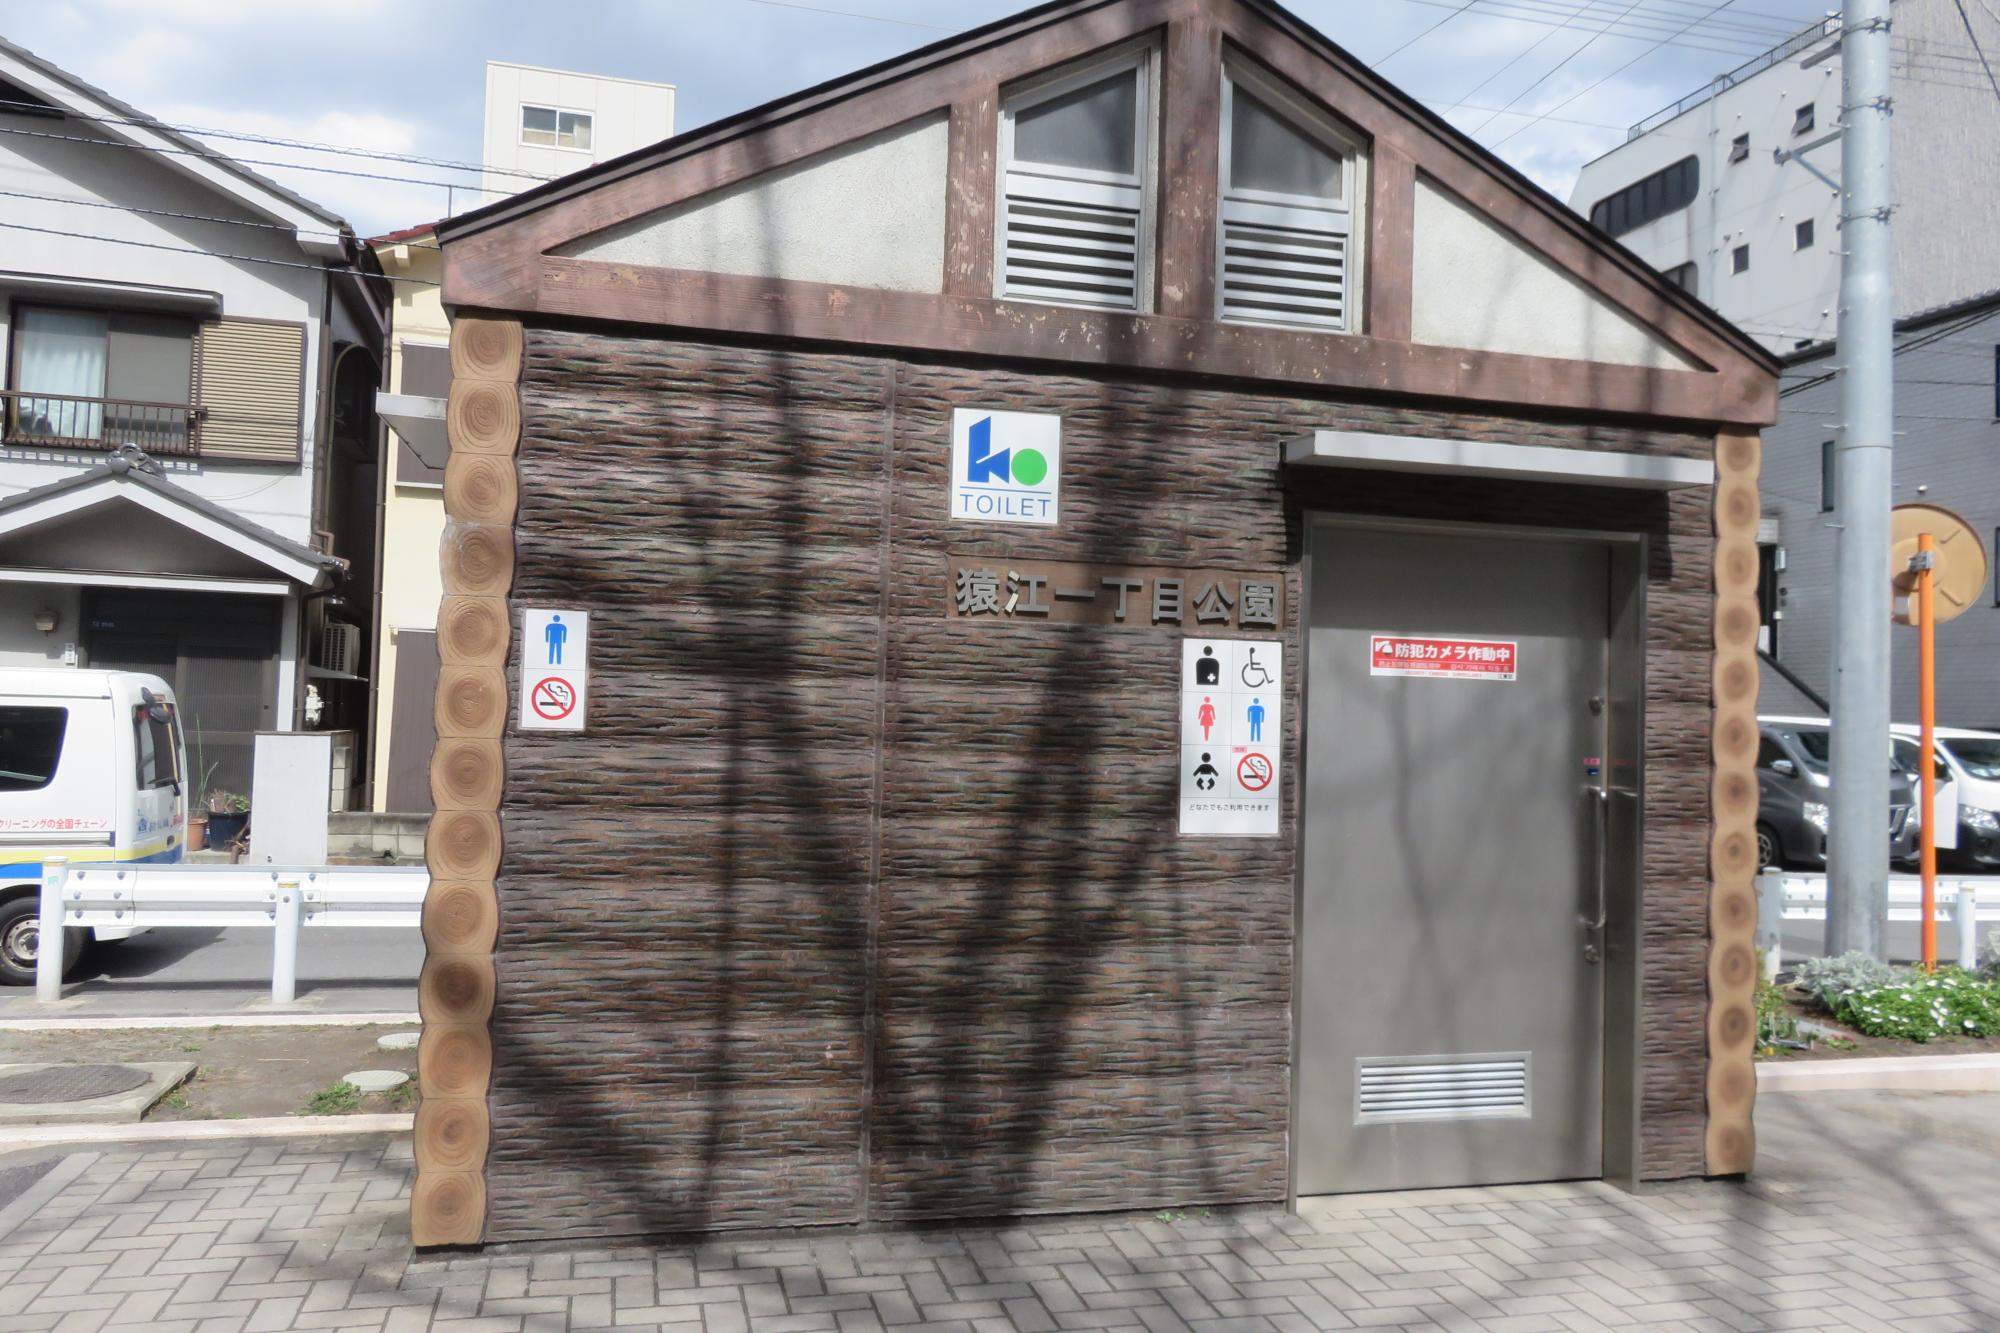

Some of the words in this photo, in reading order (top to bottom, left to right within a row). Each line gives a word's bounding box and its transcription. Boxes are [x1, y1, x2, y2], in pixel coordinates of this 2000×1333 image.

[959, 493, 1051, 517] TOILET
[956, 567, 1280, 626] 猿江一丁目公園
[1394, 643, 1510, 662] 防犯カメラ作動中
[1189, 803, 1270, 812] どなたでもご利用できます
